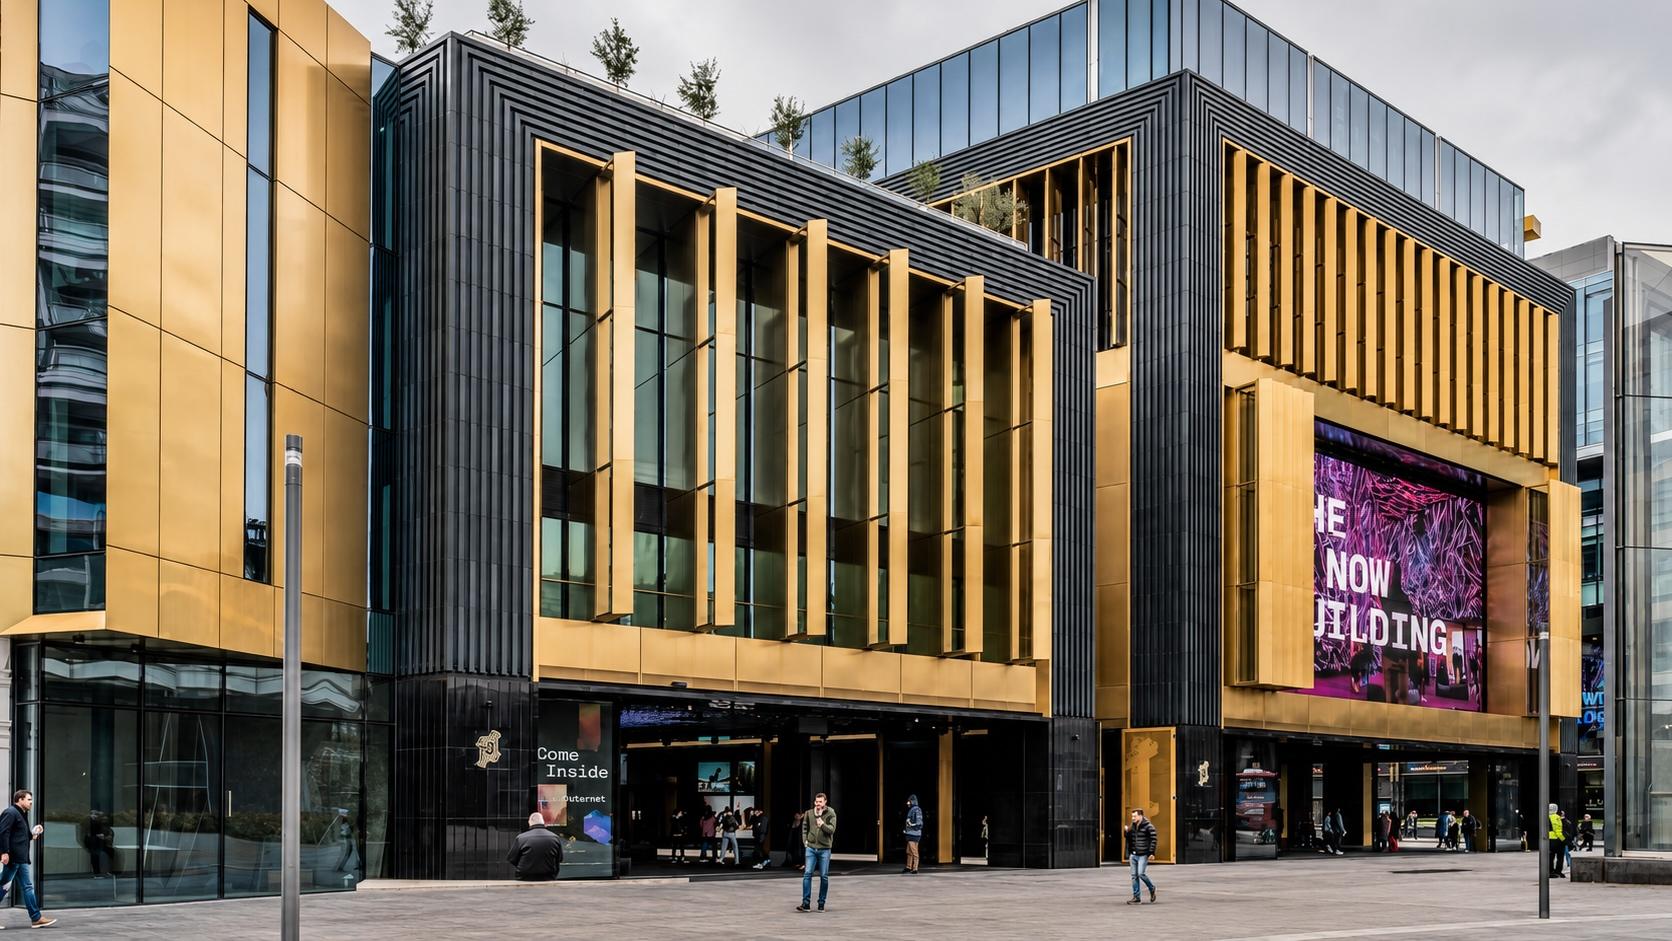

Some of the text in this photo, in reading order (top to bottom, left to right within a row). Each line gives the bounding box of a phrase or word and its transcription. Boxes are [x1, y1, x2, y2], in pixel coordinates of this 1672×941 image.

[1326, 548, 1391, 598] NOW
[537, 746, 579, 762] Come
[546, 764, 609, 779] Inside
[563, 795, 606, 803] Outernet
